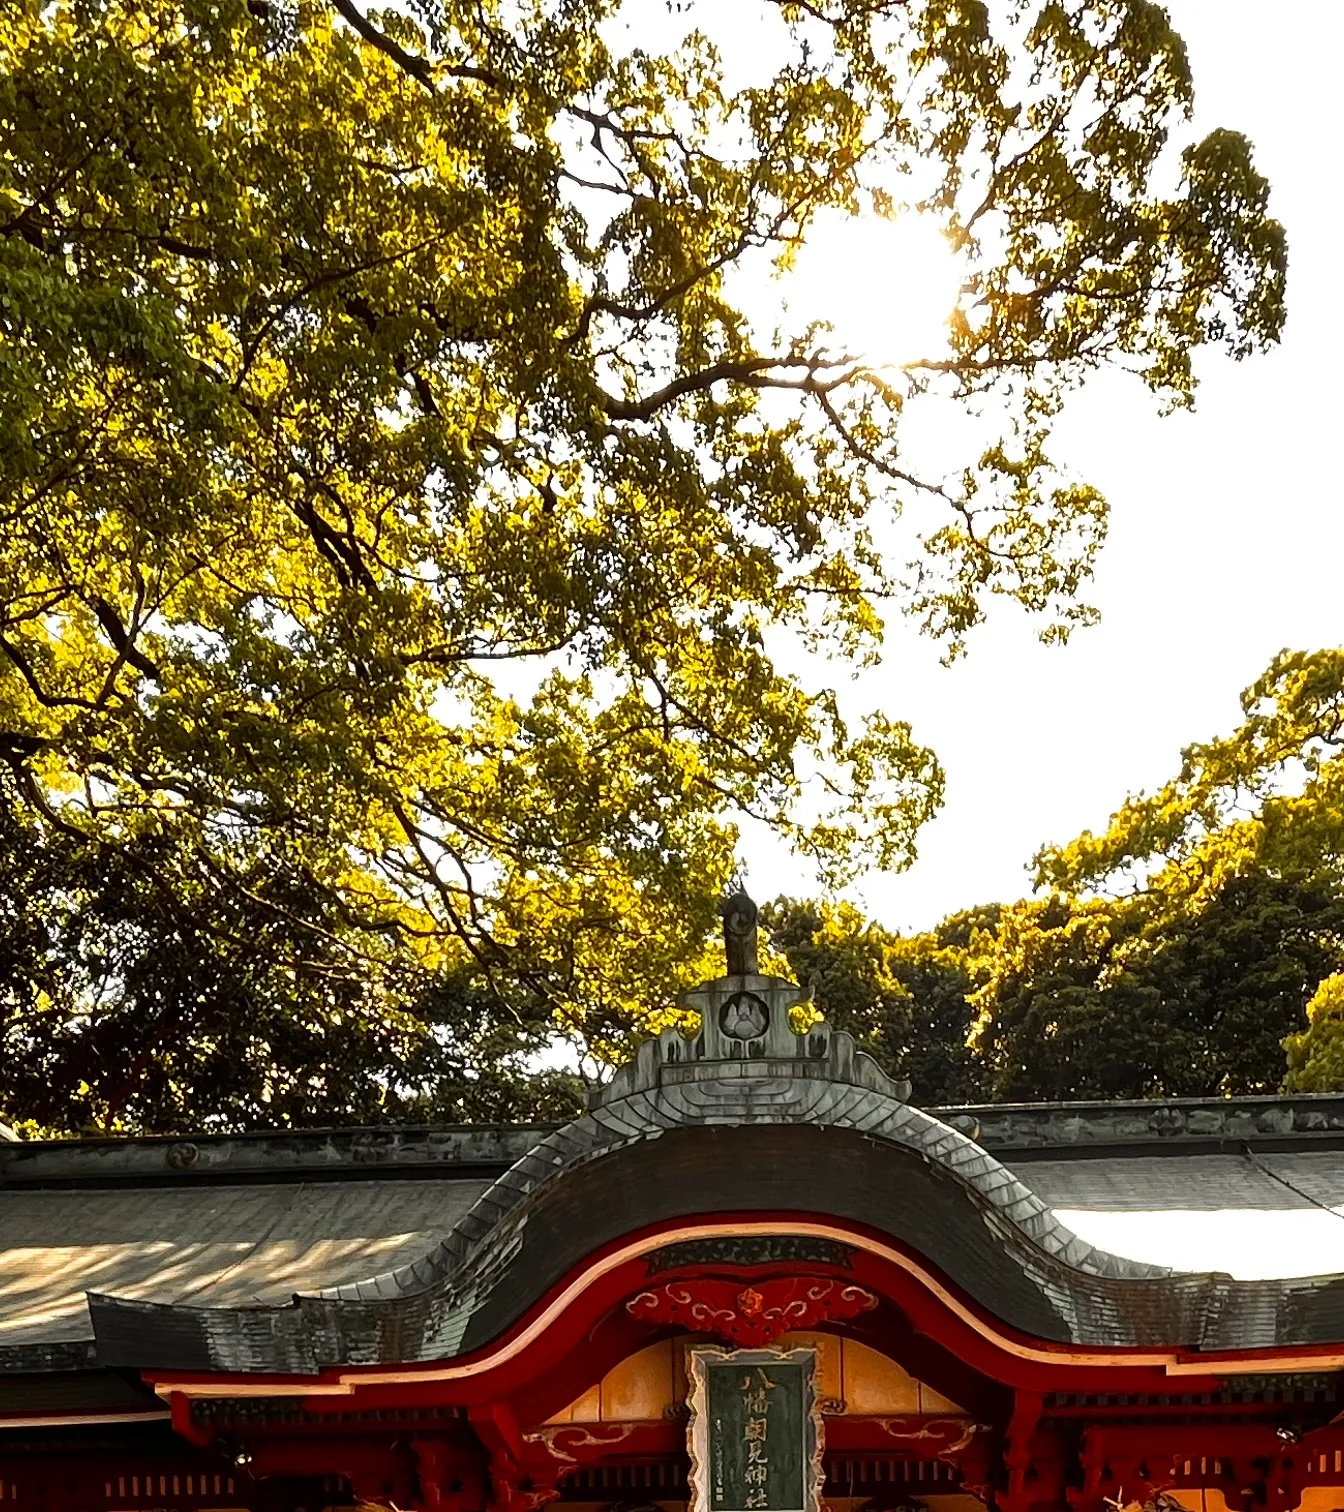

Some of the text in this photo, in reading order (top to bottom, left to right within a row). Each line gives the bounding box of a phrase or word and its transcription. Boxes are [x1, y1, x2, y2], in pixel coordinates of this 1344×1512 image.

[741, 1367, 776, 1509] 八幡朝見神社
